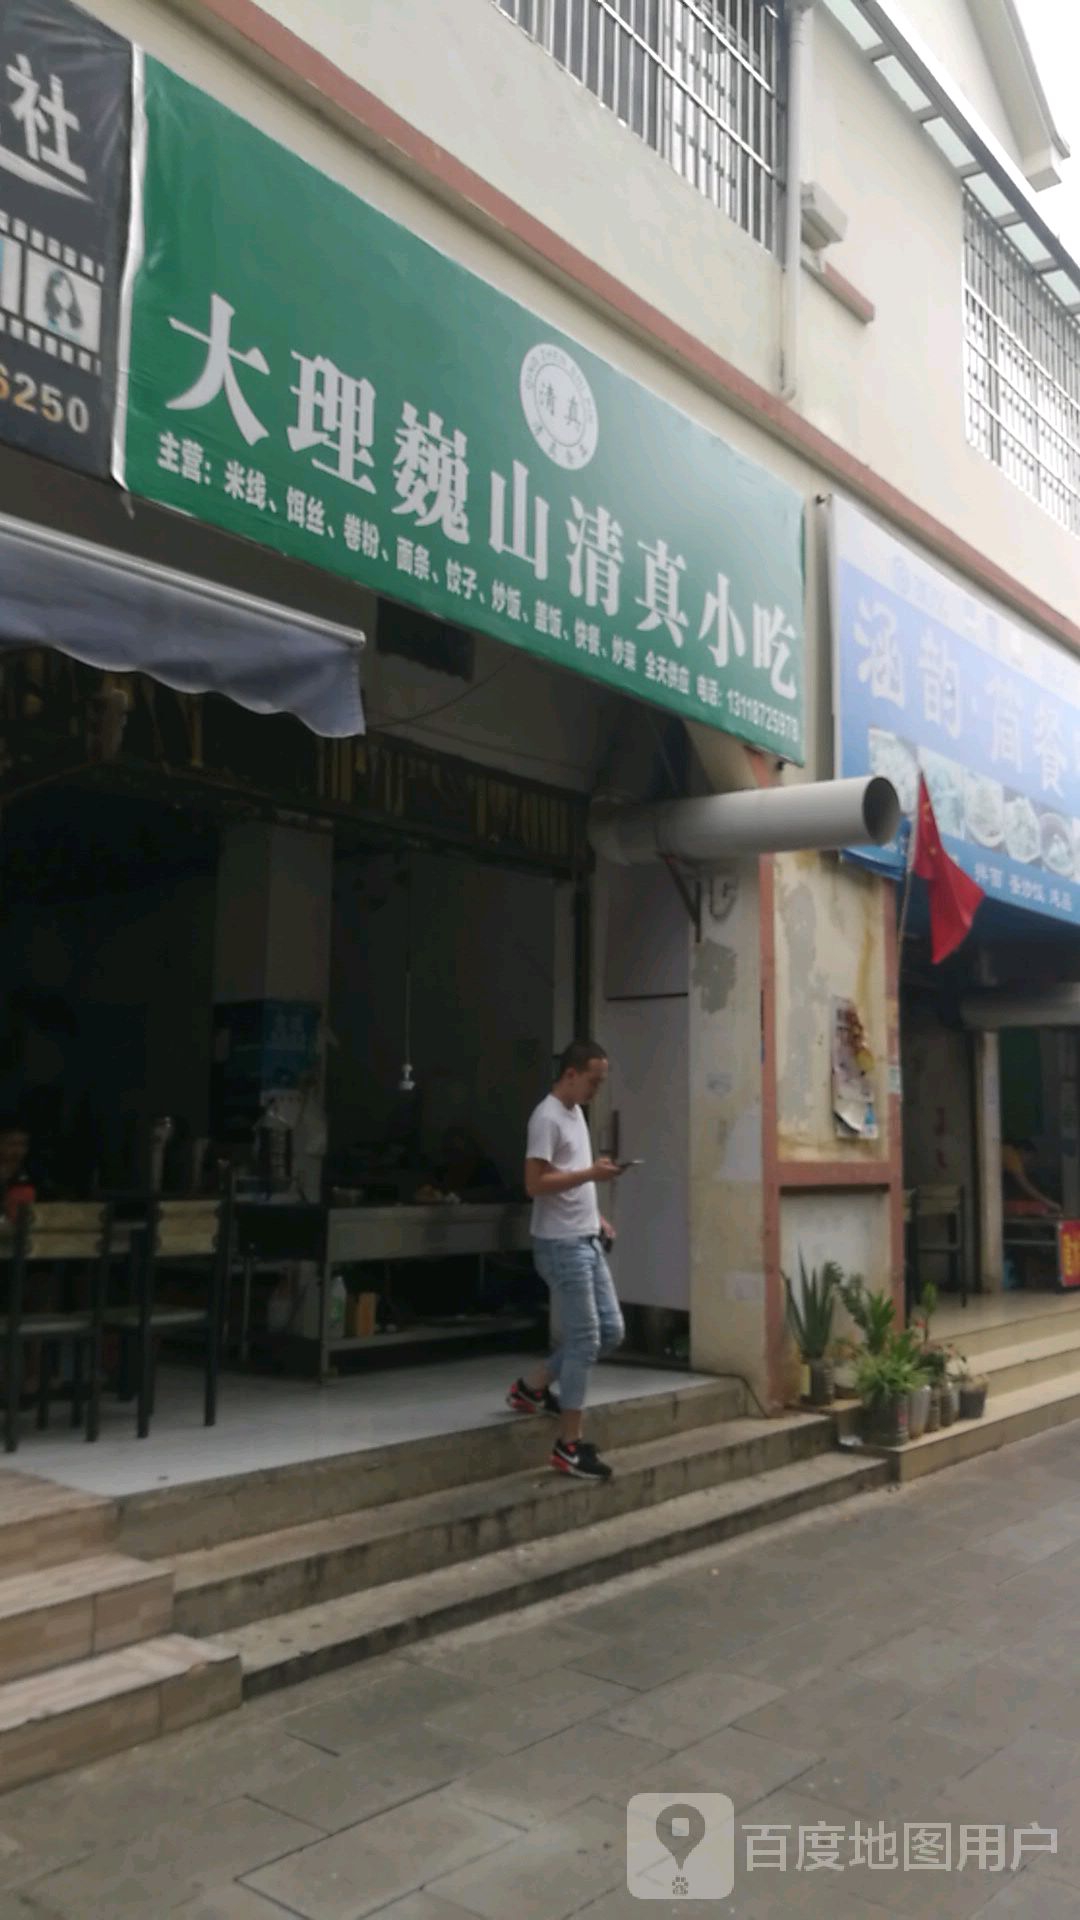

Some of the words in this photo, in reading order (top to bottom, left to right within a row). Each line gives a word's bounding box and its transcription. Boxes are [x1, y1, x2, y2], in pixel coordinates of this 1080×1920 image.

[6, 52, 88, 184] 社
[166, 292, 798, 700] 大理巍山清真小吃
